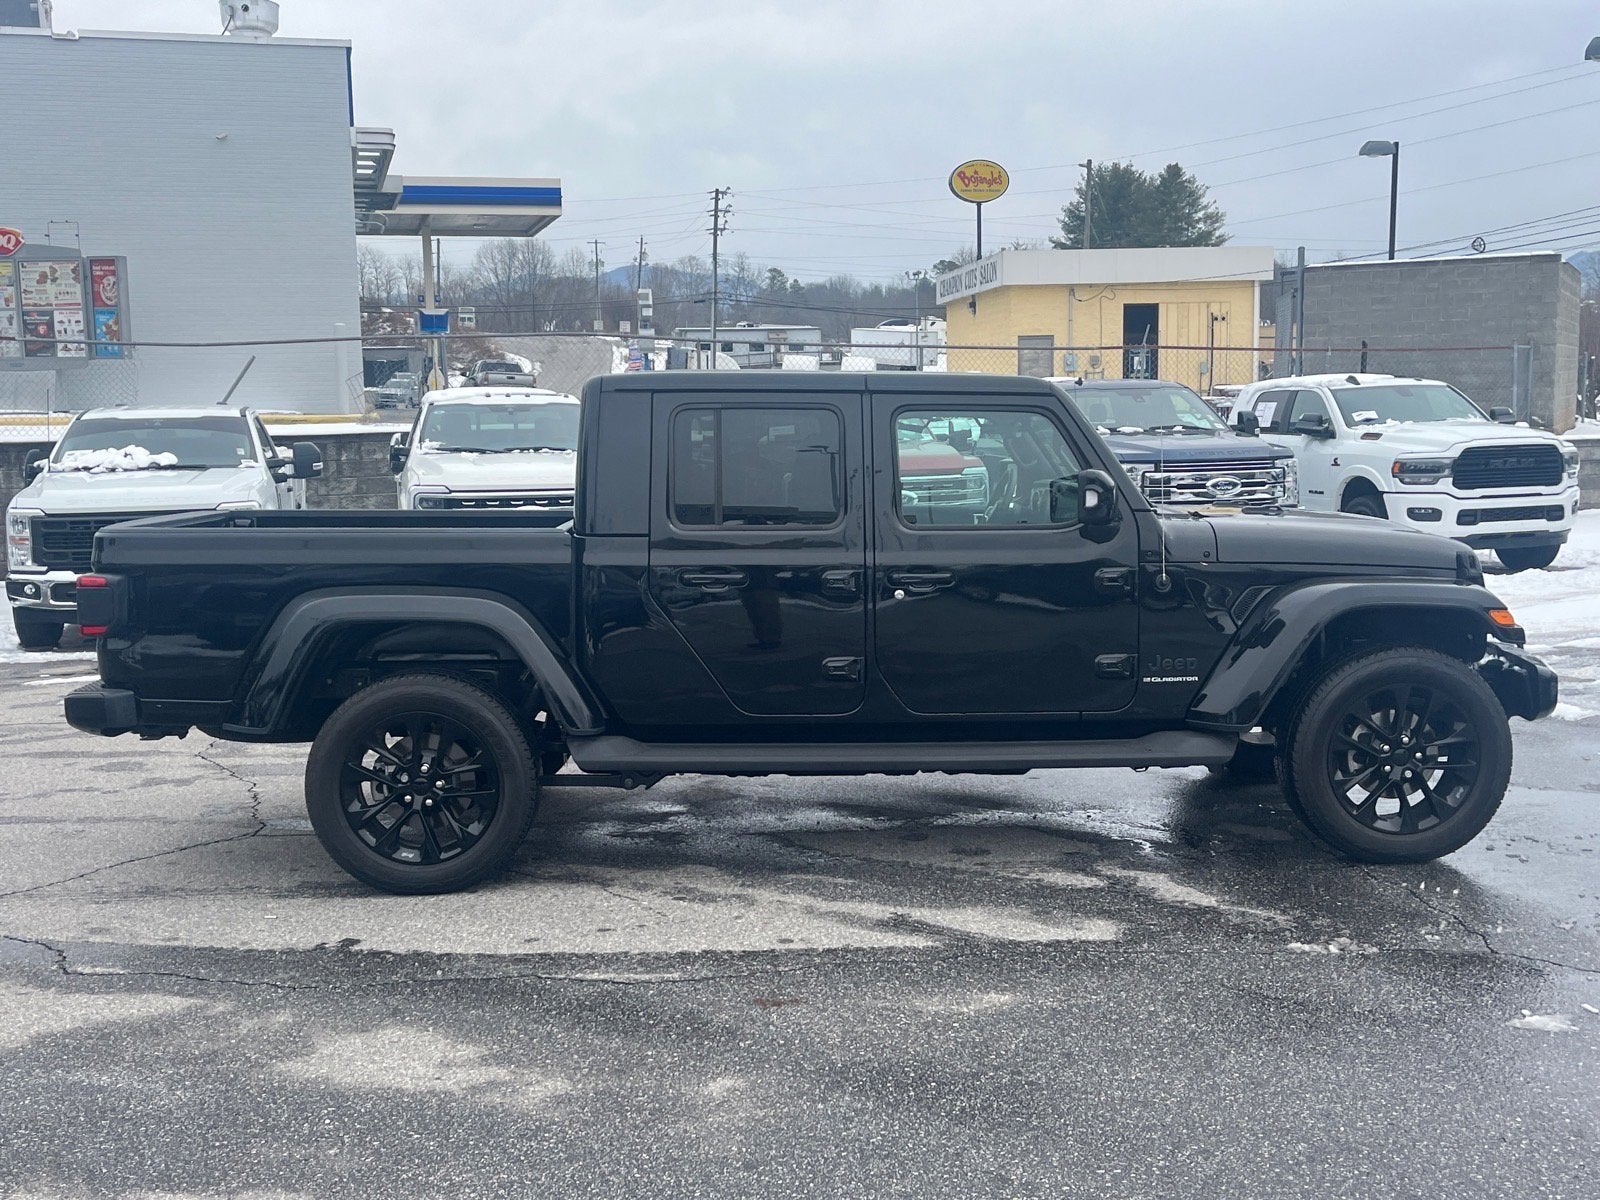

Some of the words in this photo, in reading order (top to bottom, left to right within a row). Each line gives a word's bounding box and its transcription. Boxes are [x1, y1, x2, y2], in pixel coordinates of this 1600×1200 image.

[939, 273, 963, 298] CHAMPION
[964, 267, 978, 291] CUTS
[979, 260, 998, 285] SALON
[1215, 481, 1234, 490] Ford
[1148, 654, 1200, 671] Jeep
